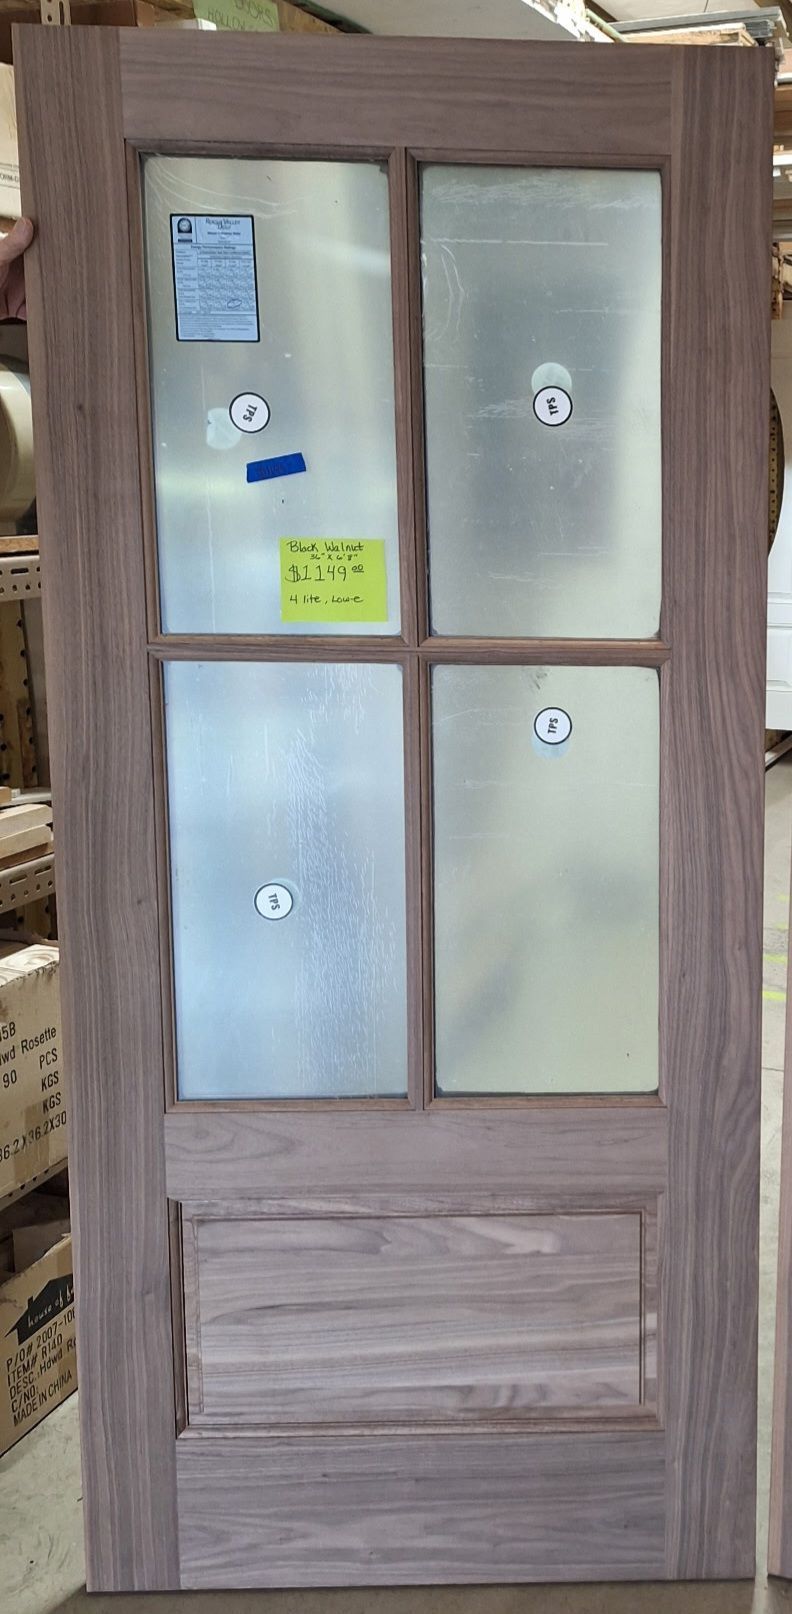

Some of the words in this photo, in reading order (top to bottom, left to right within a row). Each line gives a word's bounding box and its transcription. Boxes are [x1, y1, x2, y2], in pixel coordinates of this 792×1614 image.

[243, 404, 258, 422] TPS
[546, 397, 559, 416] TPS
[286, 540, 319, 553] Black
[324, 541, 364, 552] Walnut
[290, 594, 298, 605] 4
[547, 717, 559, 734] TPS
[268, 892, 280, 911] TPS
[0, 1044, 16, 1066] wd
[20, 1027, 57, 1054] Rosette
[2, 1069, 17, 1089] 90
[39, 1047, 58, 1070] PCS
[41, 1070, 59, 1092] KGS
[42, 1092, 61, 1115] KGS
[28, 1304, 52, 1328] house
[6, 1341, 33, 1373] P/O#
[8, 1352, 38, 1387] ITEM#
[41, 1333, 63, 1360] R140
[12, 1384, 39, 1413] C/NO:
[14, 1398, 38, 1426] MADE
[39, 1389, 48, 1407] IN
[48, 1369, 72, 1398] CHINA
